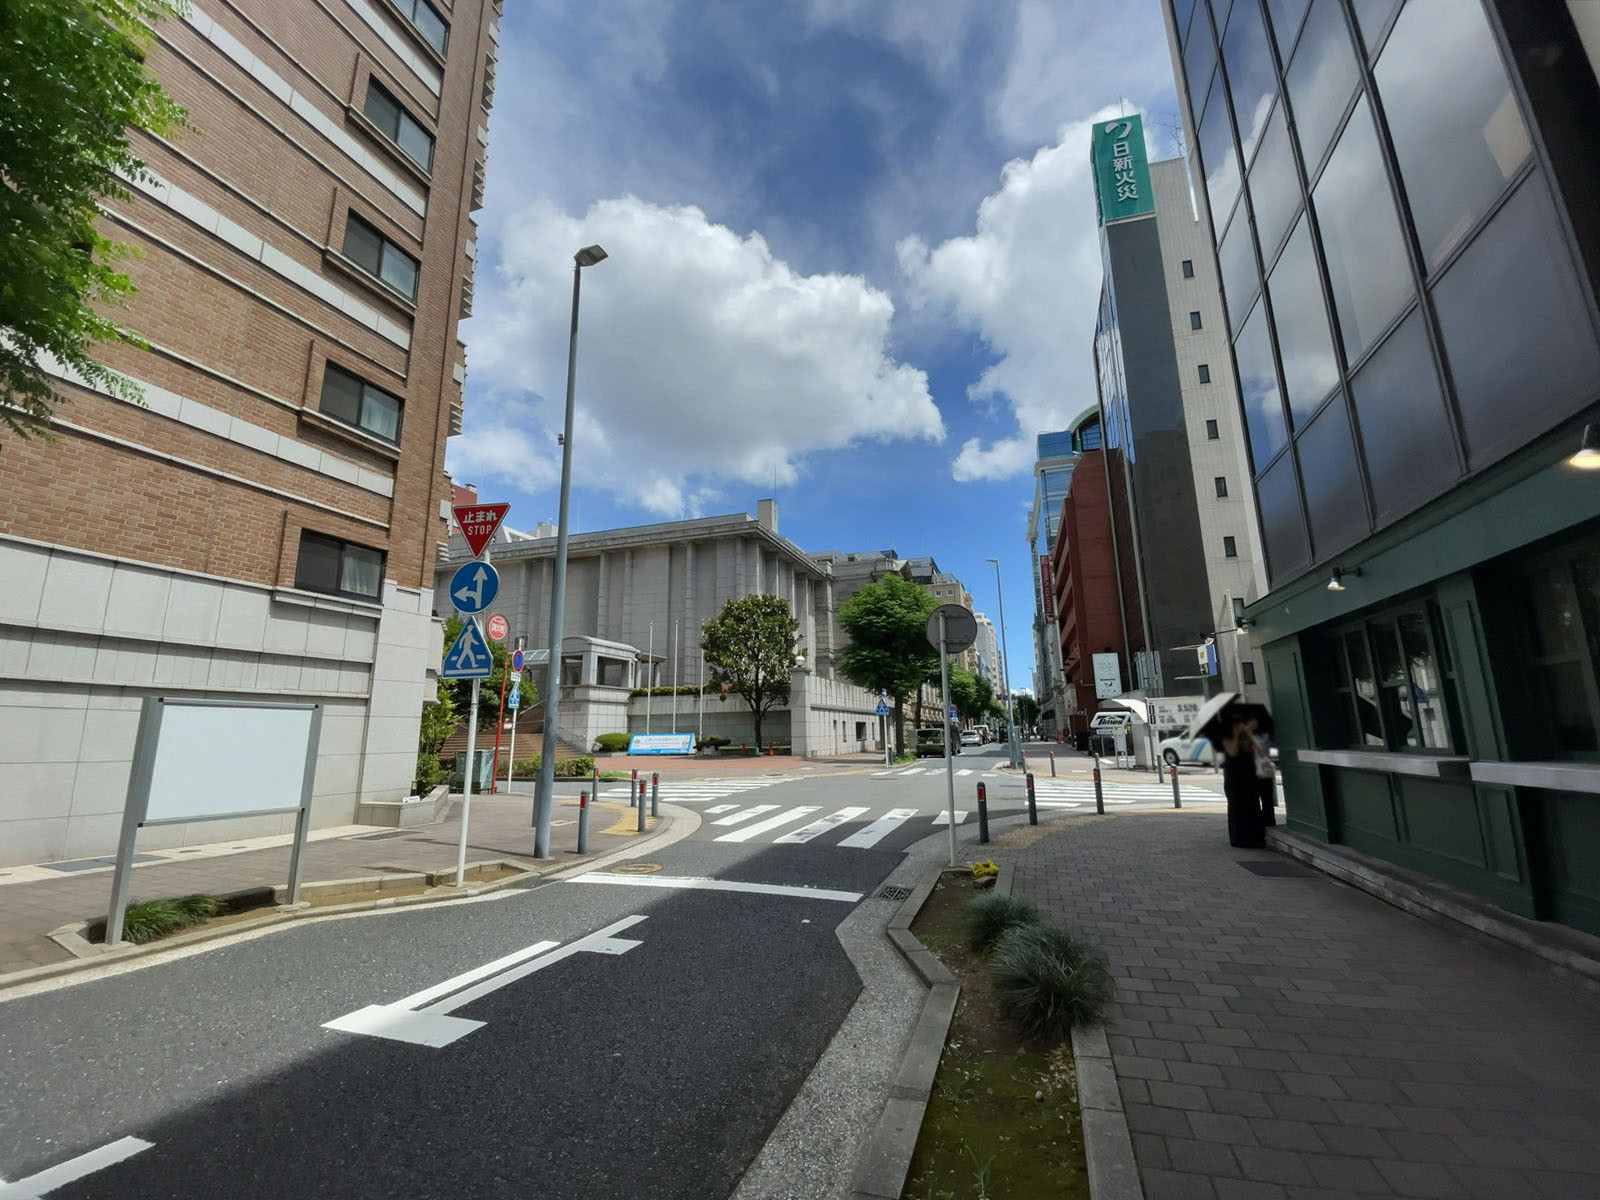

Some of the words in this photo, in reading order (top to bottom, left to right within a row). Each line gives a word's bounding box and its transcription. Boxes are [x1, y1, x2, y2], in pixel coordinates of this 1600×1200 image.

[1113, 142, 1138, 202] 日新火災
[463, 510, 498, 524] 止まれ
[467, 525, 492, 536] STOP
[1096, 716, 1124, 726] Times
